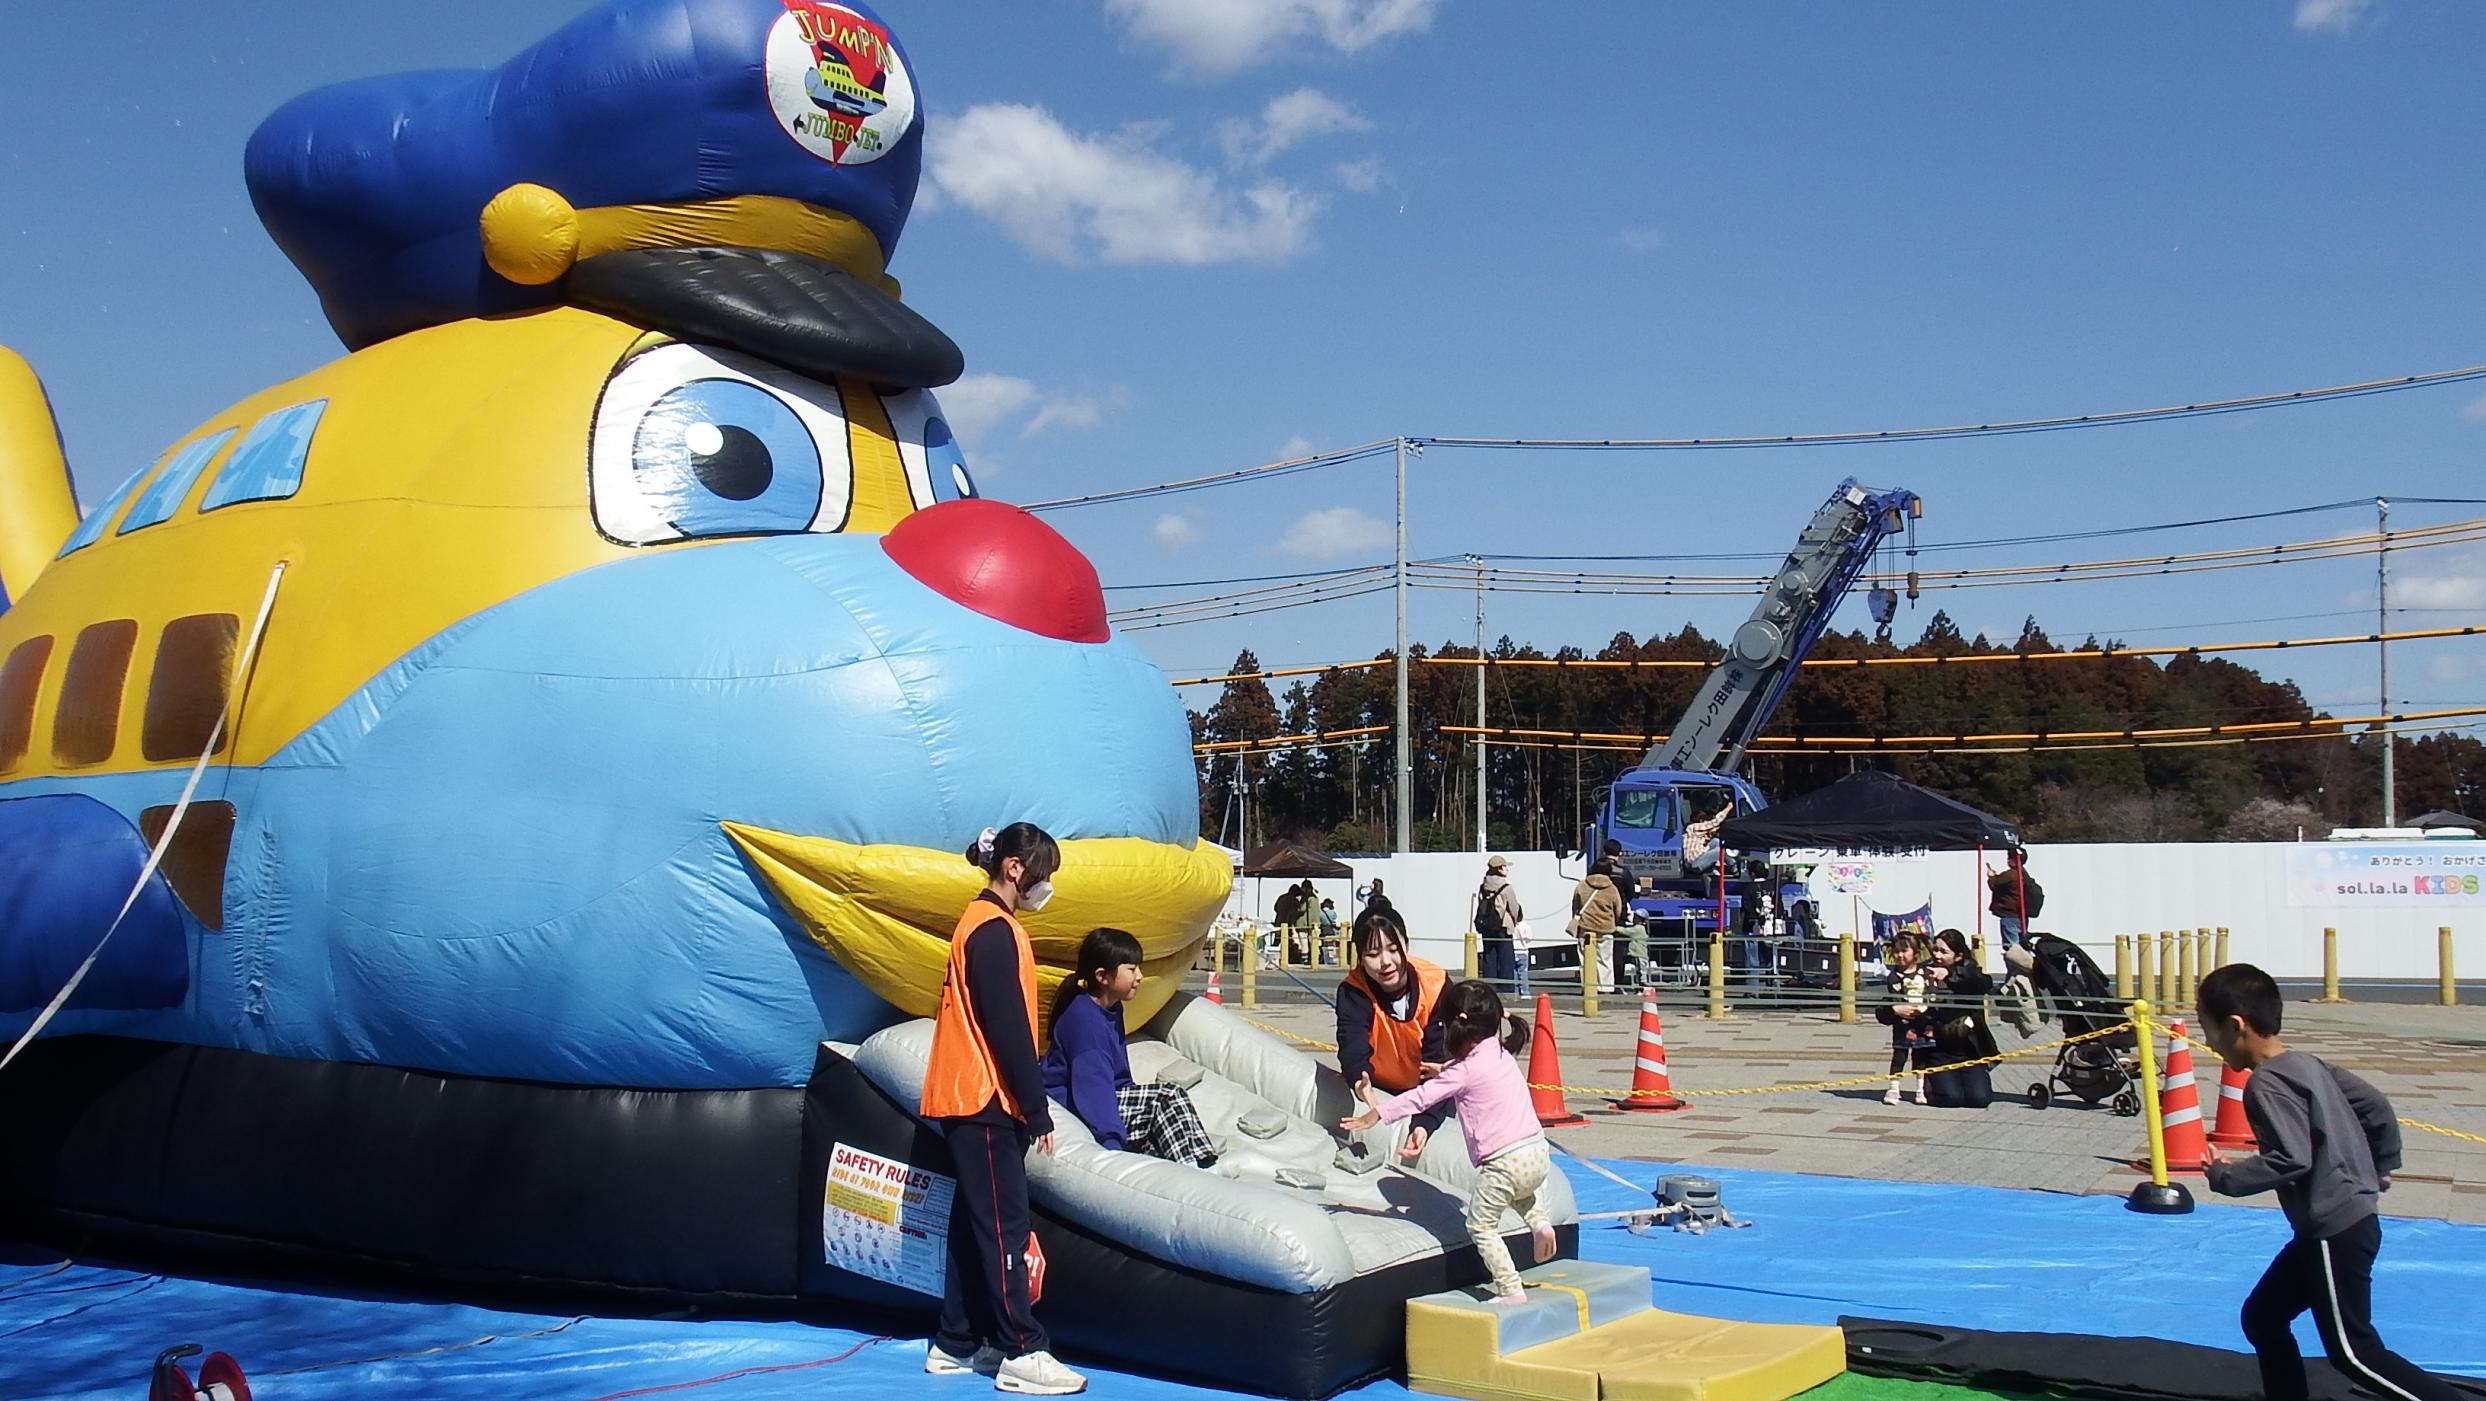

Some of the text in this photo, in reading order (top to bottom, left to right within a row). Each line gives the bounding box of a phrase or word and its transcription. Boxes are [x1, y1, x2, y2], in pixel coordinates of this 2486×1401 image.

[792, 9, 894, 74] JUMP'N
[804, 112, 881, 152] JUMBO JET
[2337, 874, 2480, 895] sol.la.la KIDS
[836, 1149, 932, 1190] SAFETY RULES
